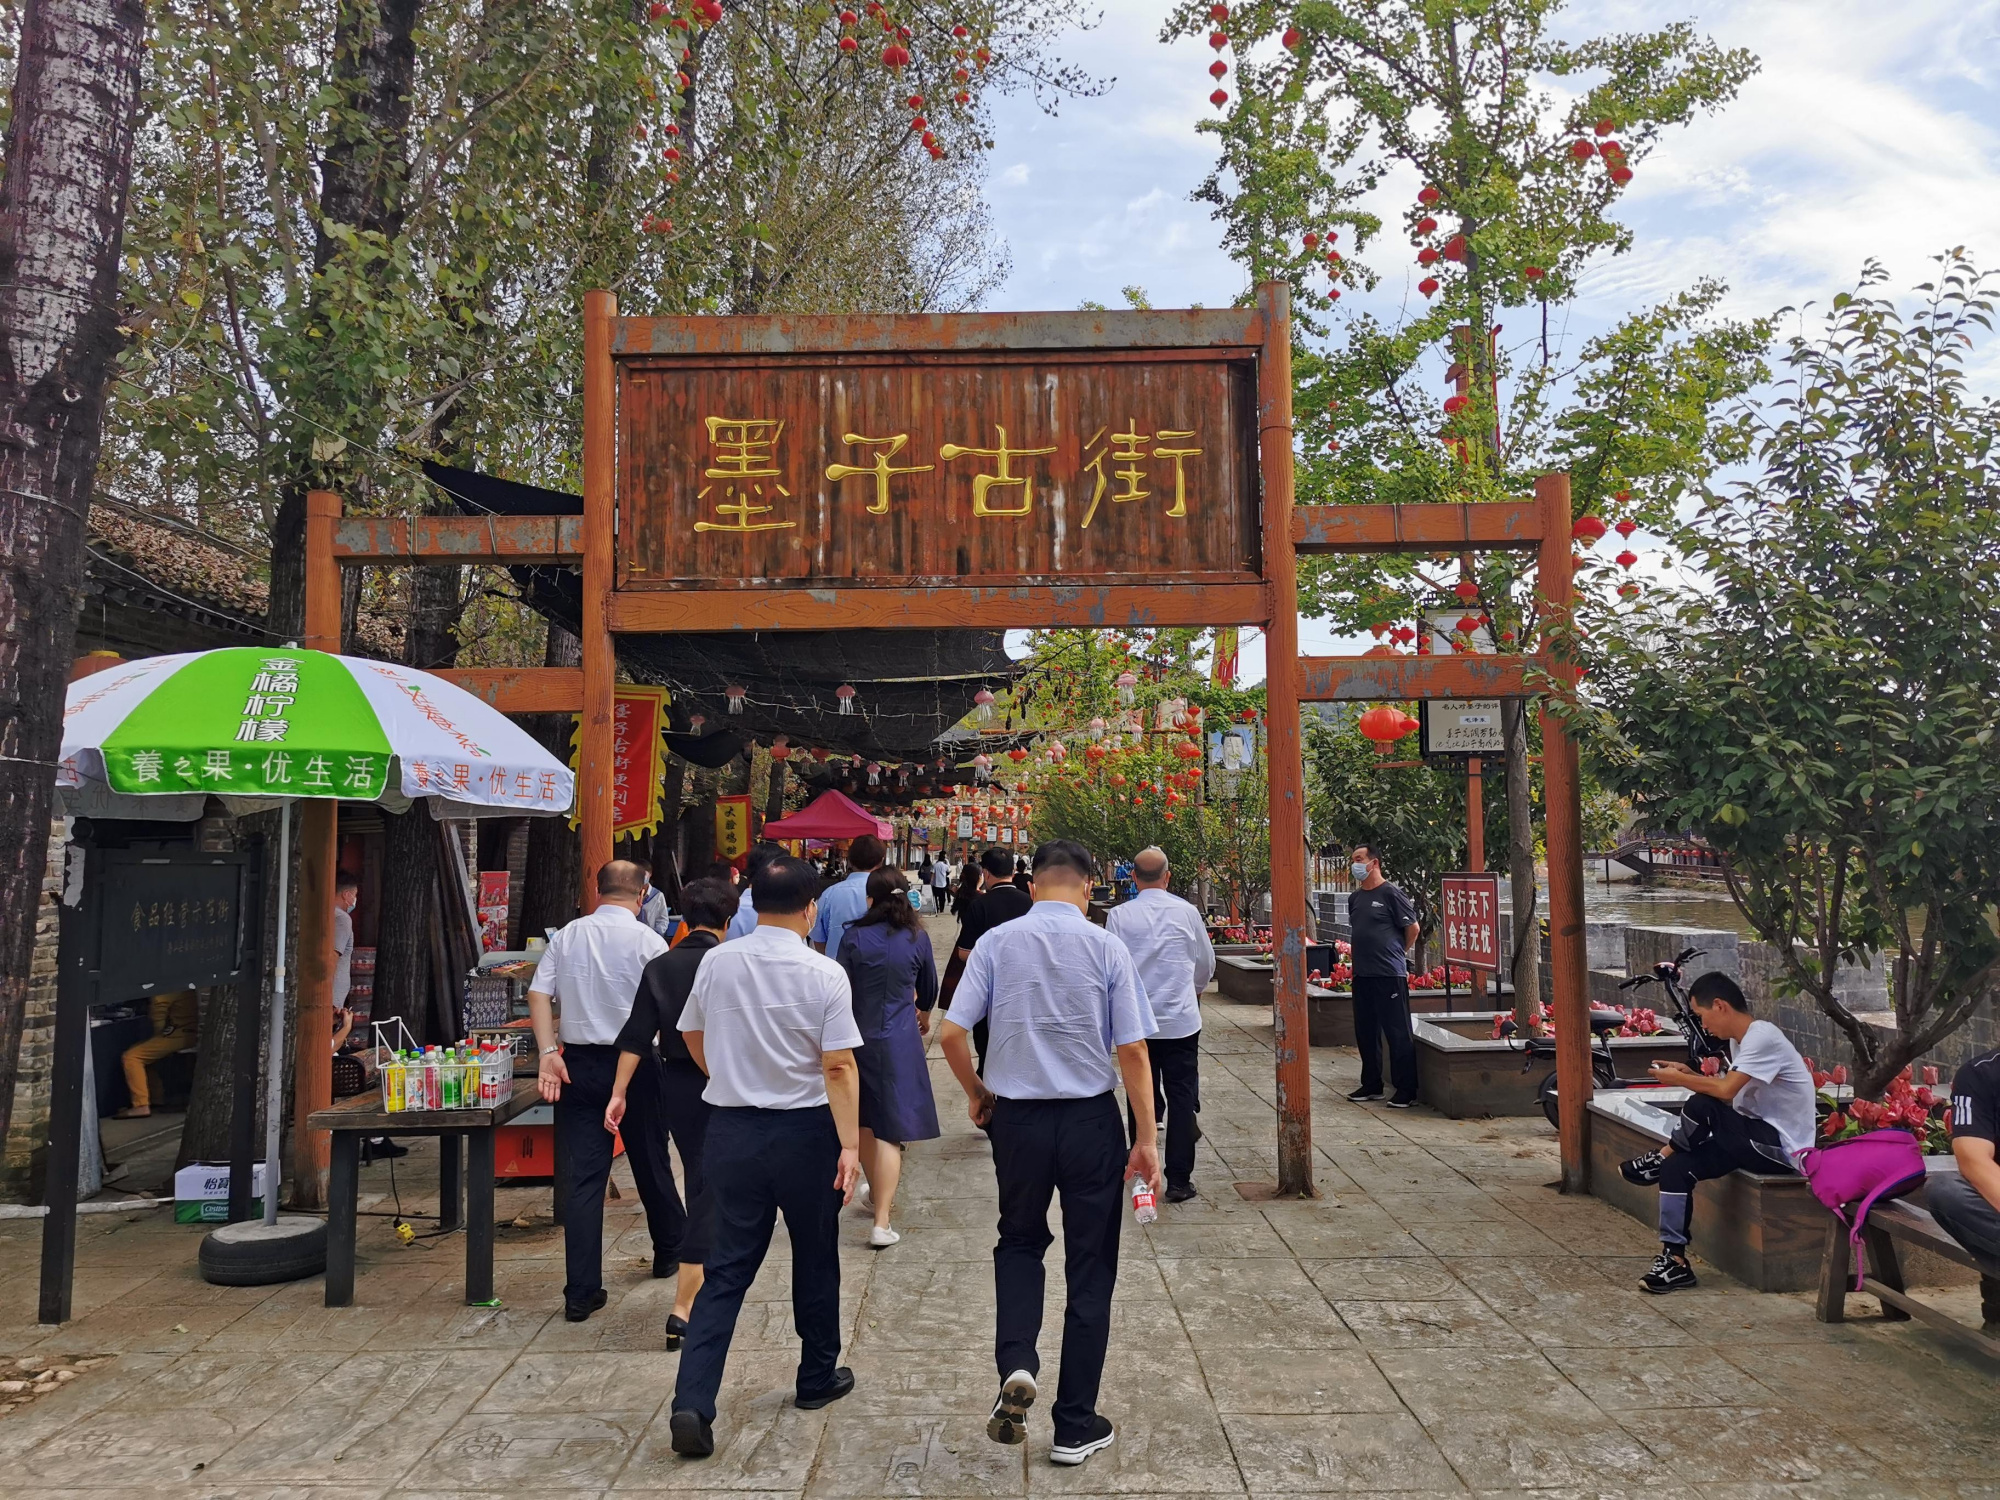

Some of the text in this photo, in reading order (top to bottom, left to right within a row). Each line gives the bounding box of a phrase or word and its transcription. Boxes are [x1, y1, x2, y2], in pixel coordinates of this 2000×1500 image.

[693, 415, 1203, 533] 墨子古街
[233, 657, 305, 742] 金橘柠檬
[1446, 889, 1490, 919] 法行天下
[1448, 921, 1491, 954] 食者无忧
